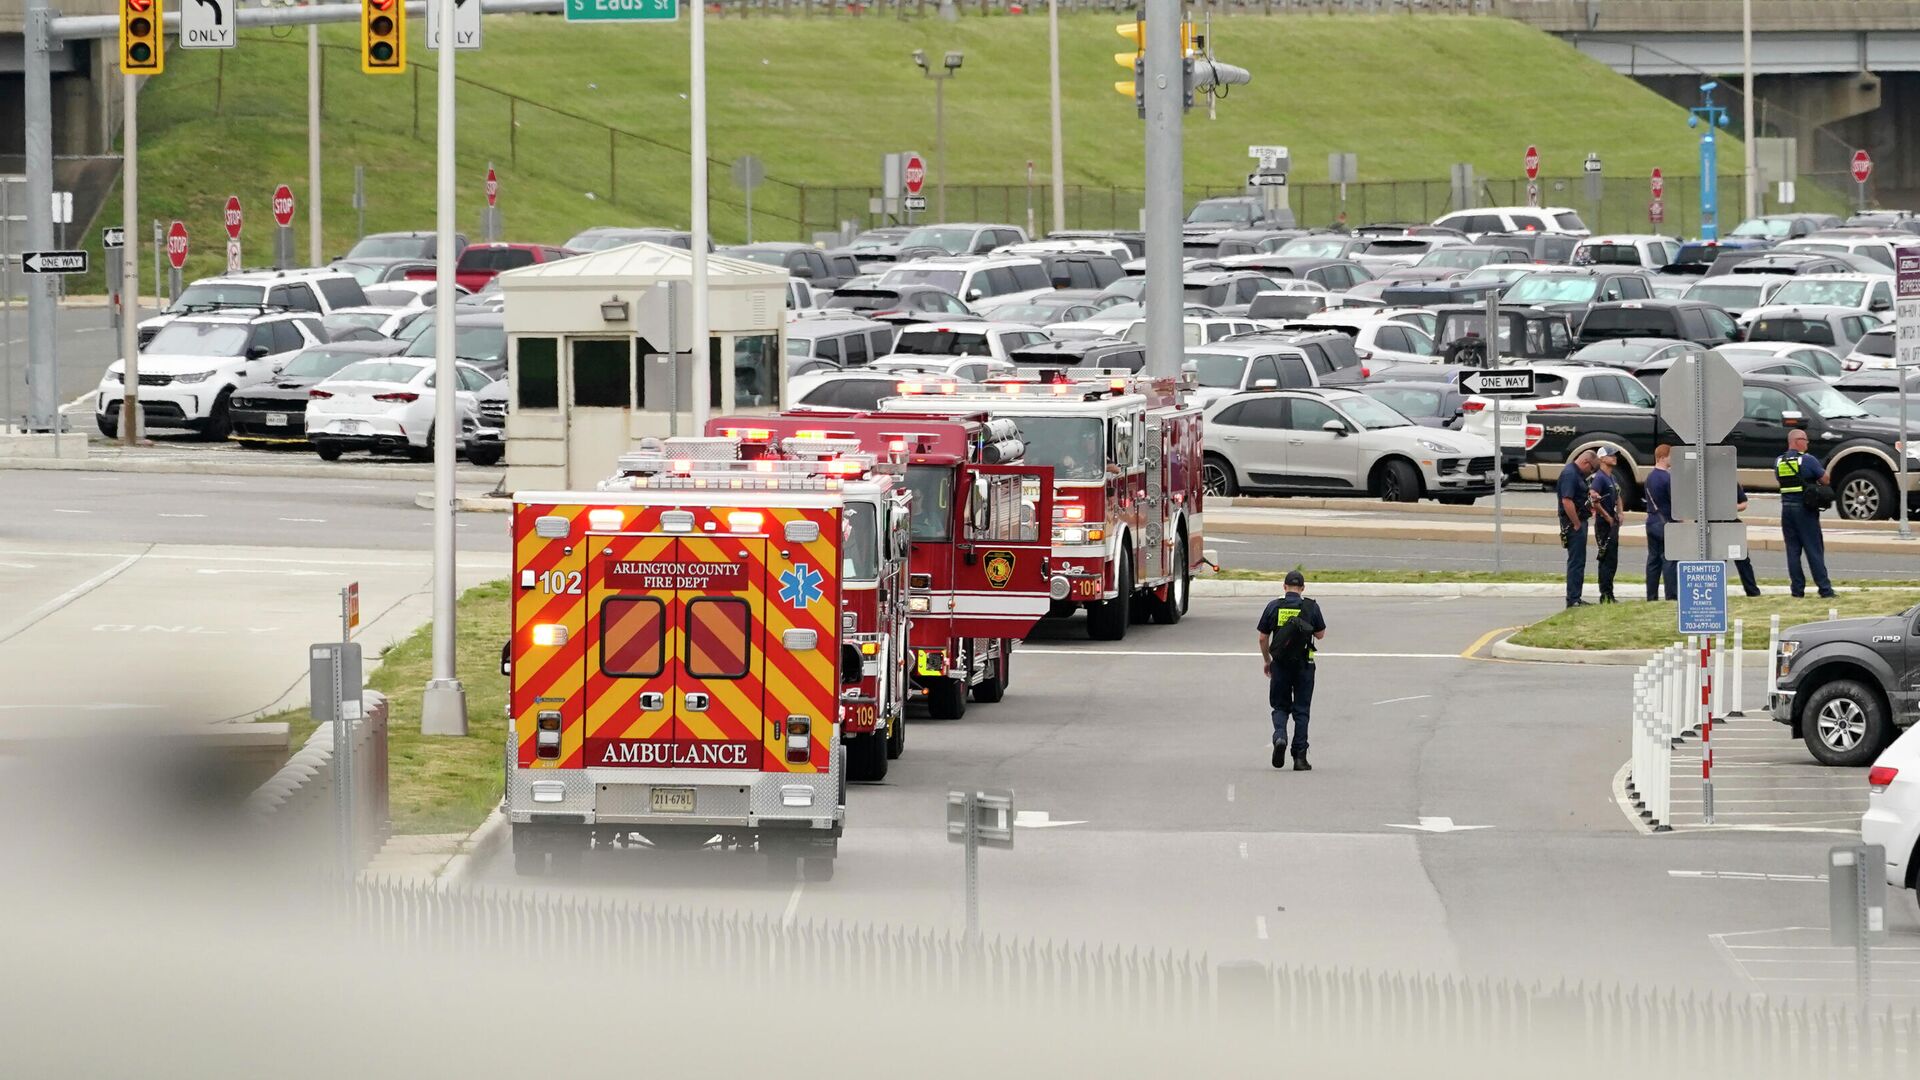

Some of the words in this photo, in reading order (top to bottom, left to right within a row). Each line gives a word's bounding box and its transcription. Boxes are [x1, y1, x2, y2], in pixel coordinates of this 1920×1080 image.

[189, 29, 227, 42] ONLY
[434, 31, 474, 44] OLY
[1526, 156, 1539, 169] STOP
[274, 198, 292, 214] STOP
[225, 210, 240, 226] STOP
[169, 236, 187, 254] STOP
[41, 258, 59, 267] ONE
[62, 258, 80, 267] WAY
[1481, 377, 1501, 387] ONE
[1504, 376, 1526, 386] WAY
[613, 562, 685, 575] ARLINGTON
[688, 563, 740, 576] COUNTY
[1683, 565, 1720, 573] PERMITTED
[539, 570, 582, 595] 102
[644, 576, 673, 588] FIRE
[676, 576, 709, 589] DEPT
[1686, 574, 1717, 582] PARKING
[1080, 580, 1095, 596] 101
[1692, 588, 1712, 600] S-C
[856, 706, 874, 726] 109
[601, 742, 748, 764] AMBULANCE
[654, 794, 692, 805] 211-678L
